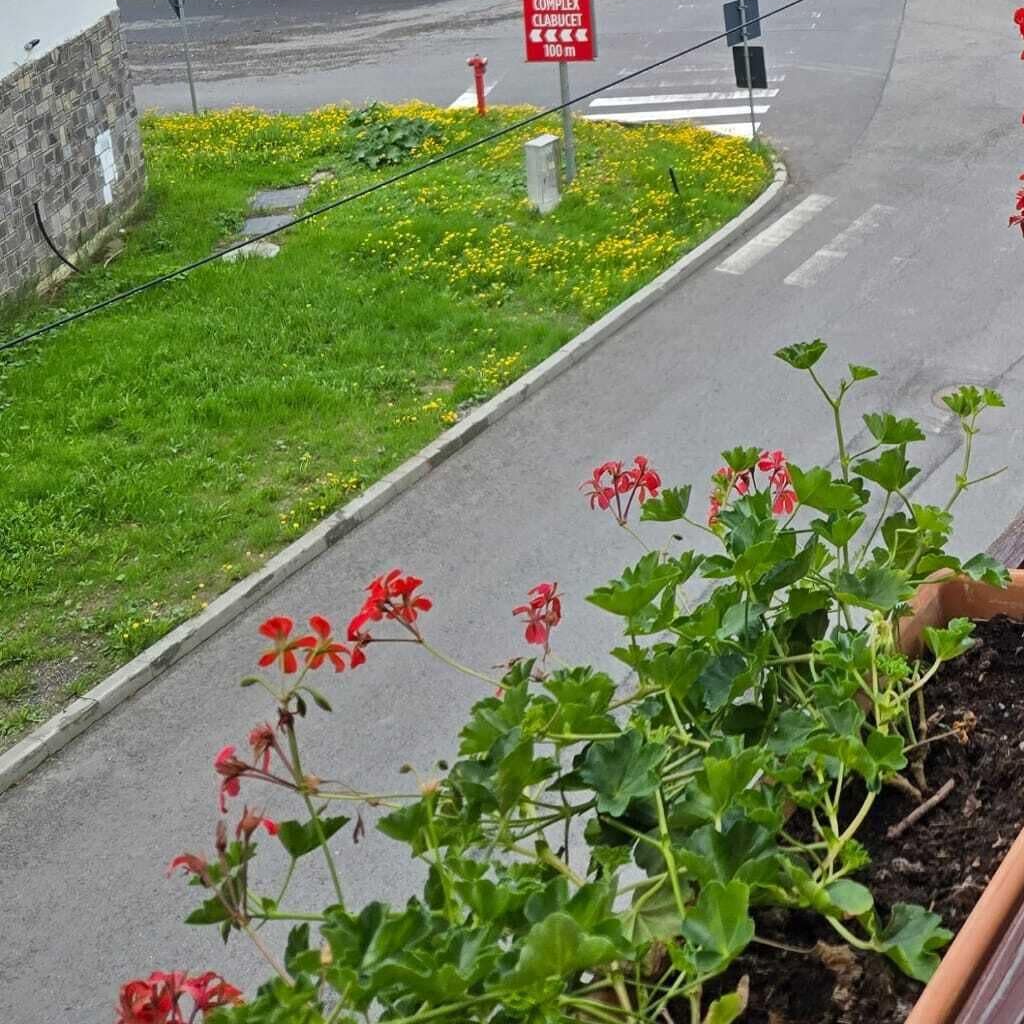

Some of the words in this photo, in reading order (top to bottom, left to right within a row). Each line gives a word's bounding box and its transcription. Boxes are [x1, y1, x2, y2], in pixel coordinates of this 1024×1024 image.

[532, 13, 583, 27] CLABUCET
[543, 43, 563, 57] 100
[564, 46, 576, 57] m
